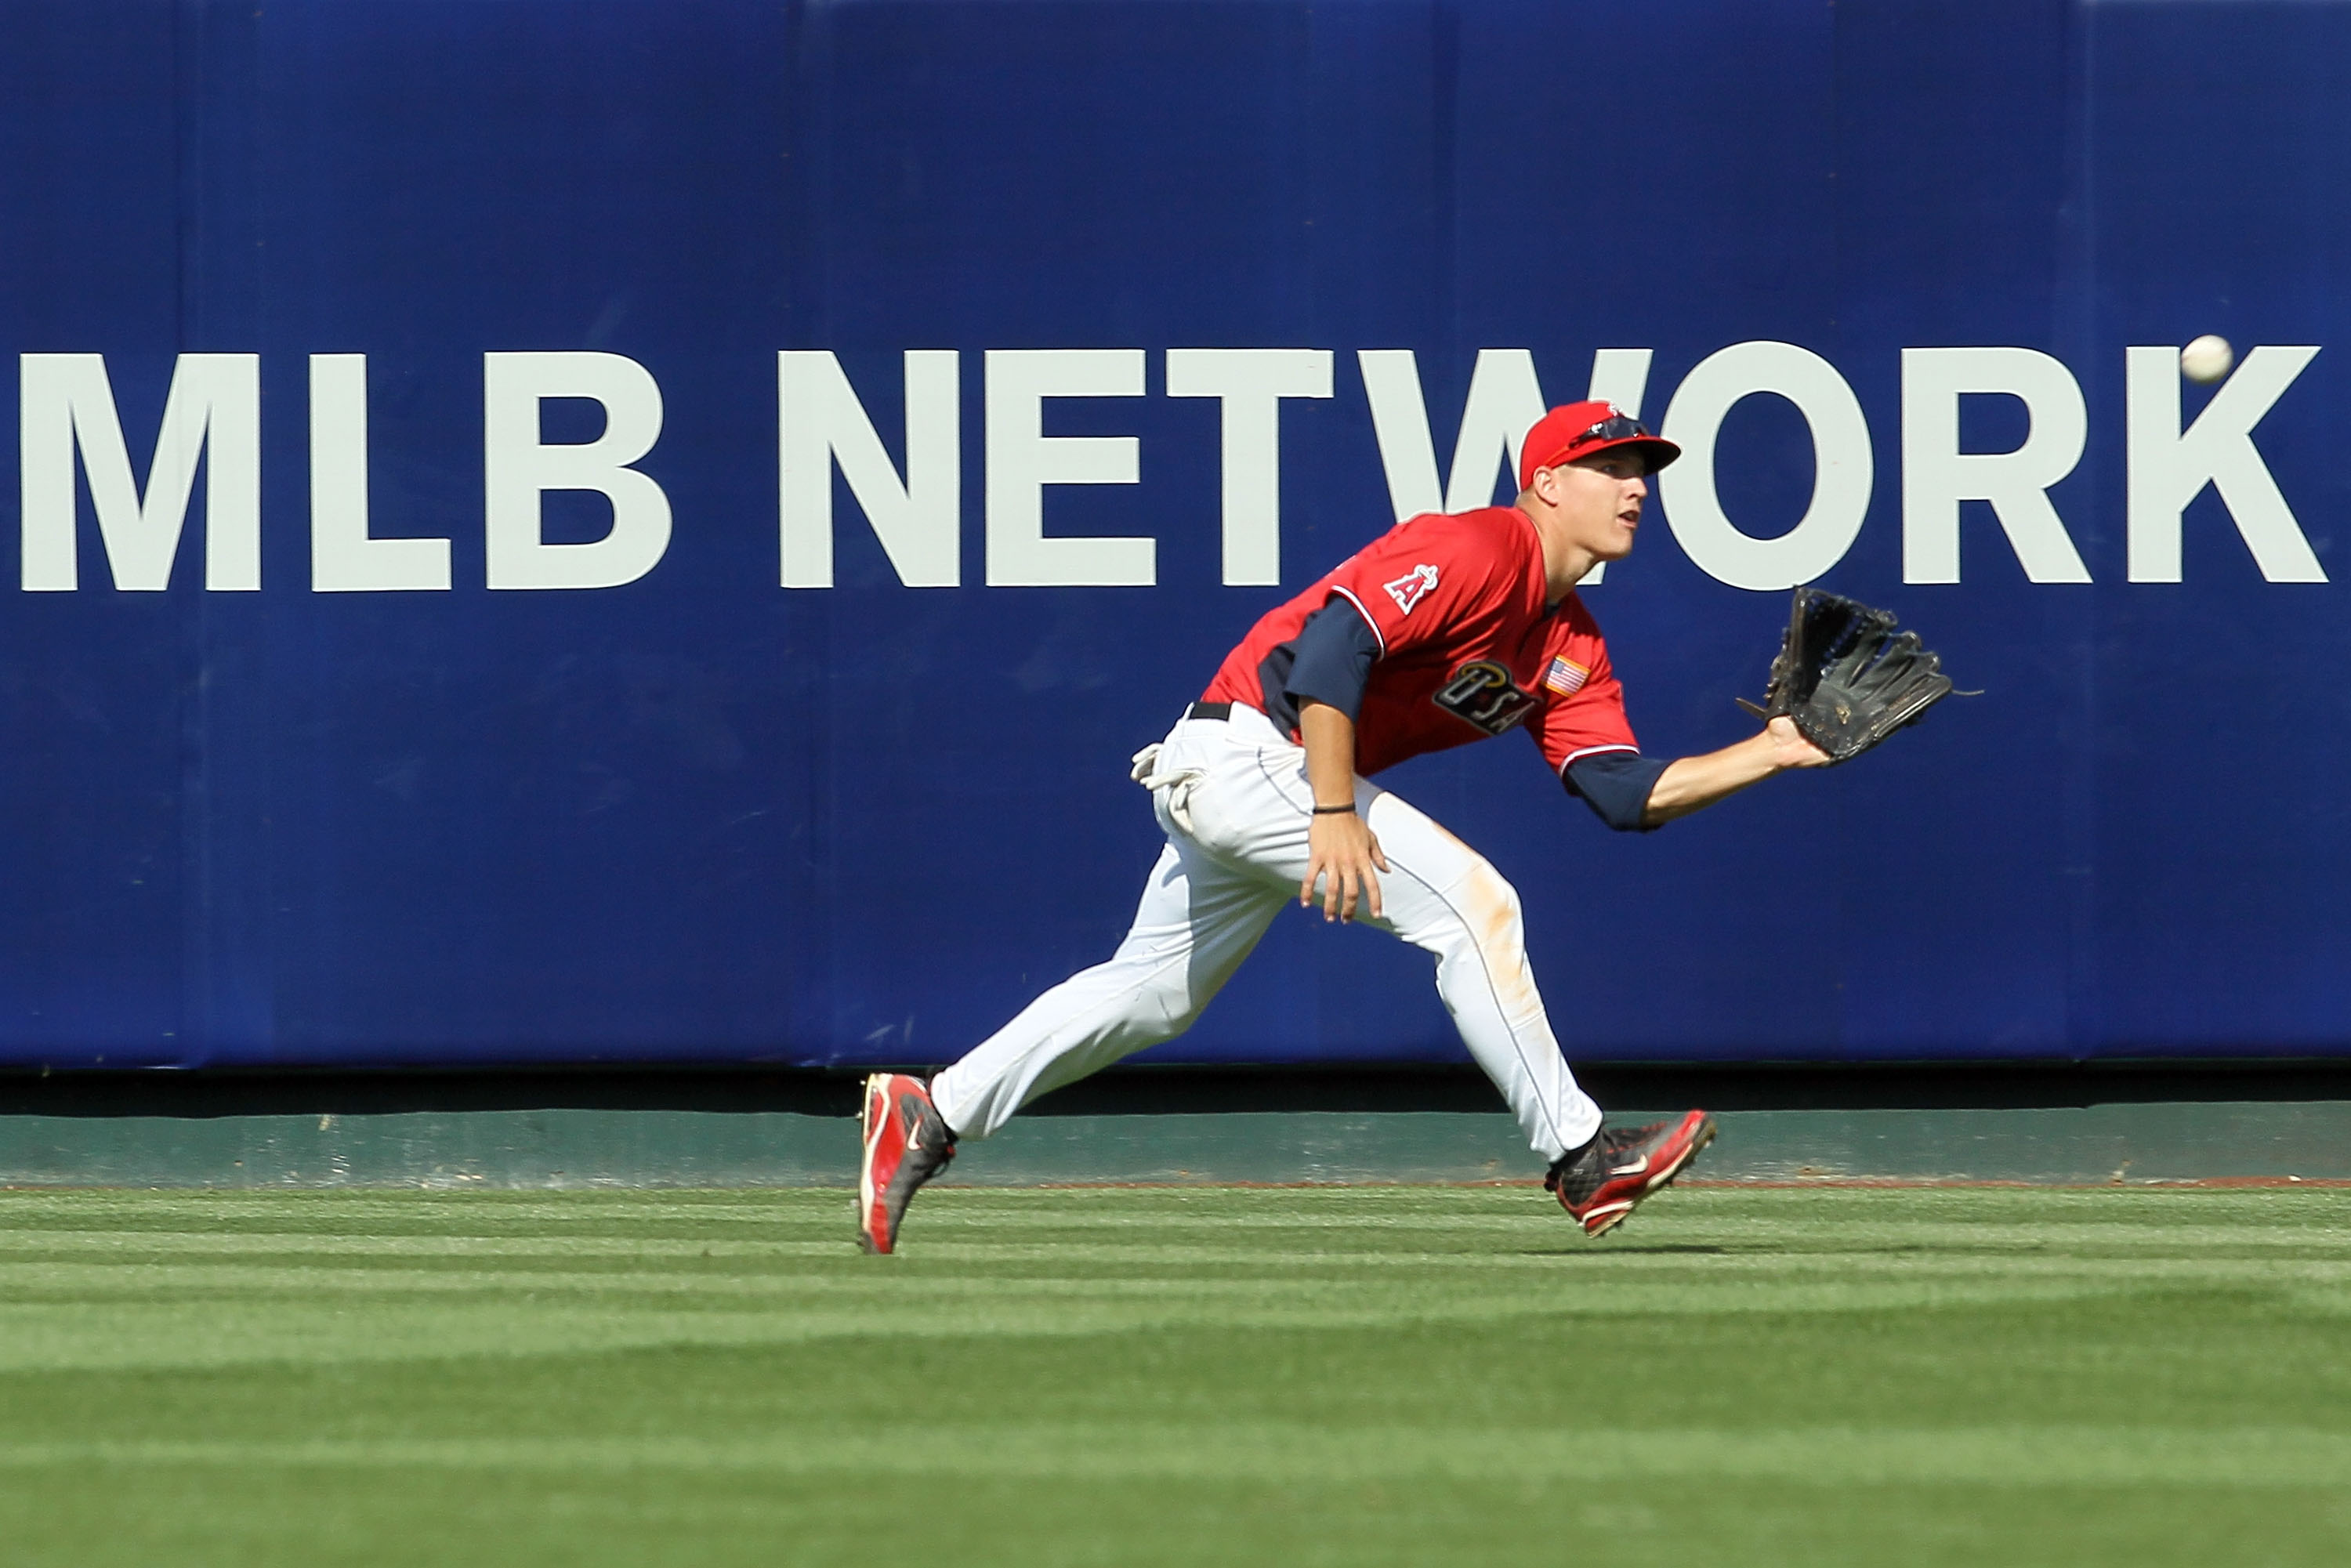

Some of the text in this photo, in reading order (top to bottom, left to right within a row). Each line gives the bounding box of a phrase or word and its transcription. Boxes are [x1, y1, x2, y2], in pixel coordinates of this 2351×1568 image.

[20, 341, 2330, 592] MLB NETWORK
[1382, 564, 1439, 616] A
[1438, 667, 1536, 733] USA
